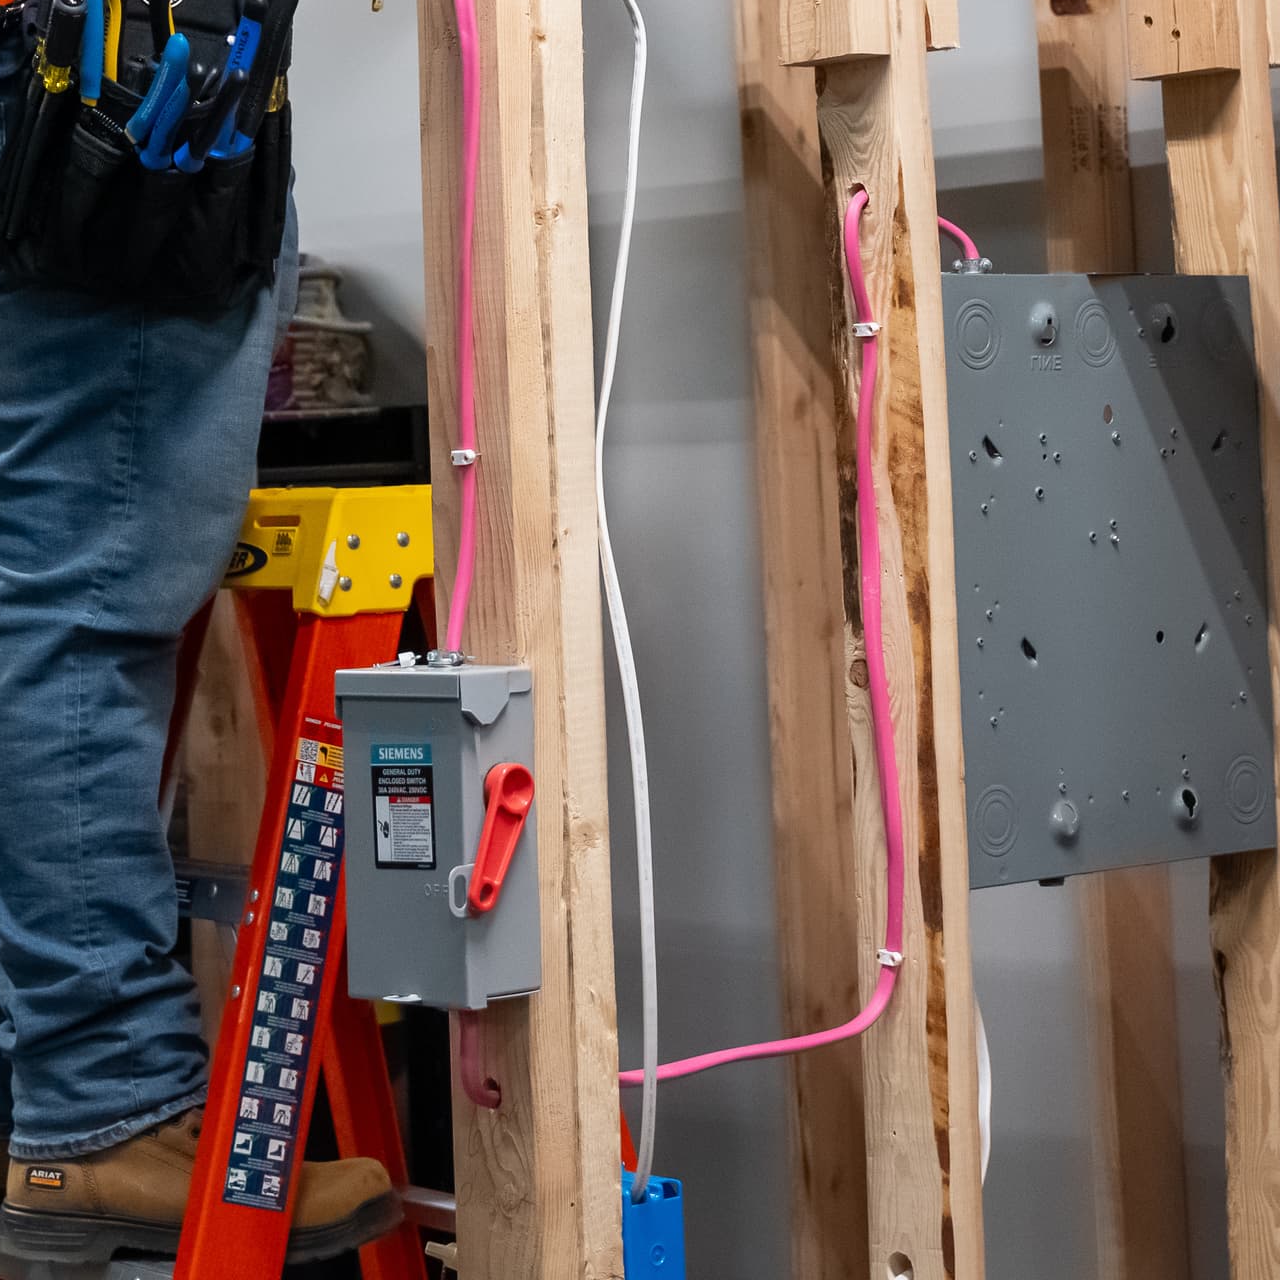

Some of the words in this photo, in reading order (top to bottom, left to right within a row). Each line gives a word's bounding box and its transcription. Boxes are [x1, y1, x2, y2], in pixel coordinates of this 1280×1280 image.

[232, 30, 250, 66] TOOLS
[378, 747, 424, 760] SIEMENS
[382, 768, 406, 776] GENERAL
[30, 1169, 62, 1180] ARIAT
